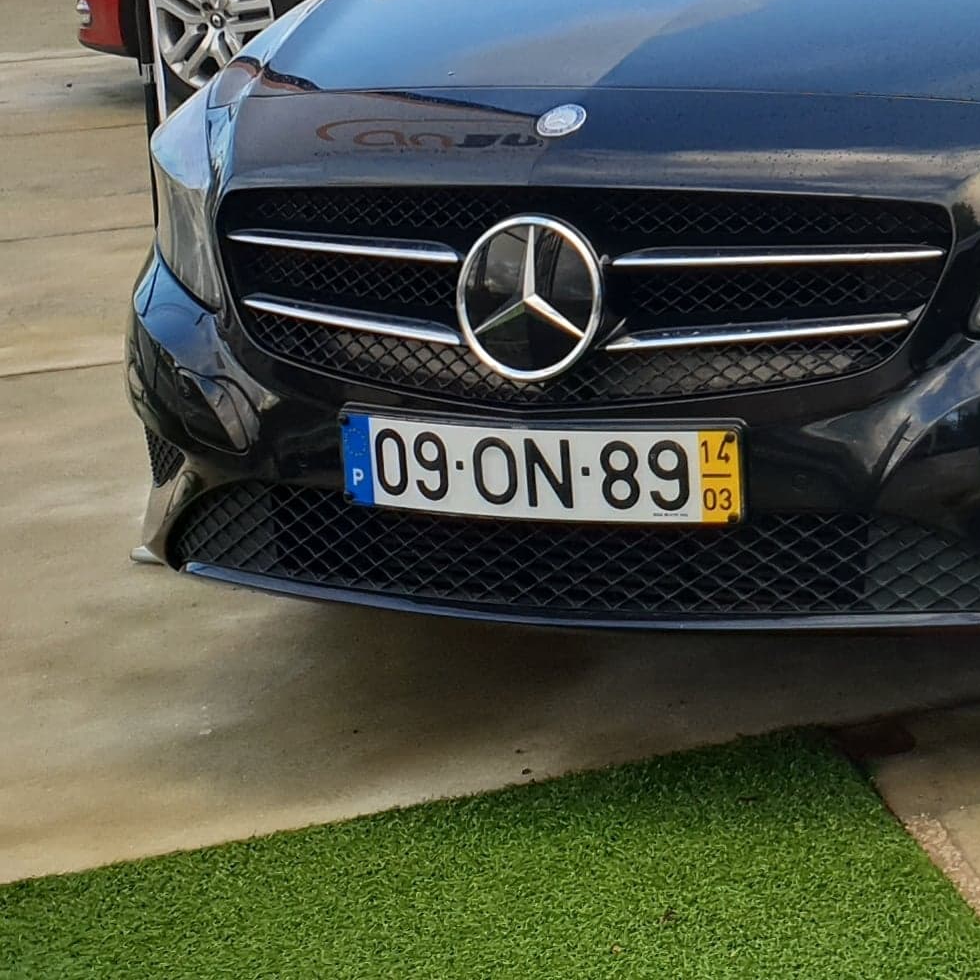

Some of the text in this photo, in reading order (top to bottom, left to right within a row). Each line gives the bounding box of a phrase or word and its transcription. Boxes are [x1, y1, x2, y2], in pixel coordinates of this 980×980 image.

[700, 440, 732, 463] 14
[352, 468, 364, 486] P
[703, 488, 733, 511] 03
